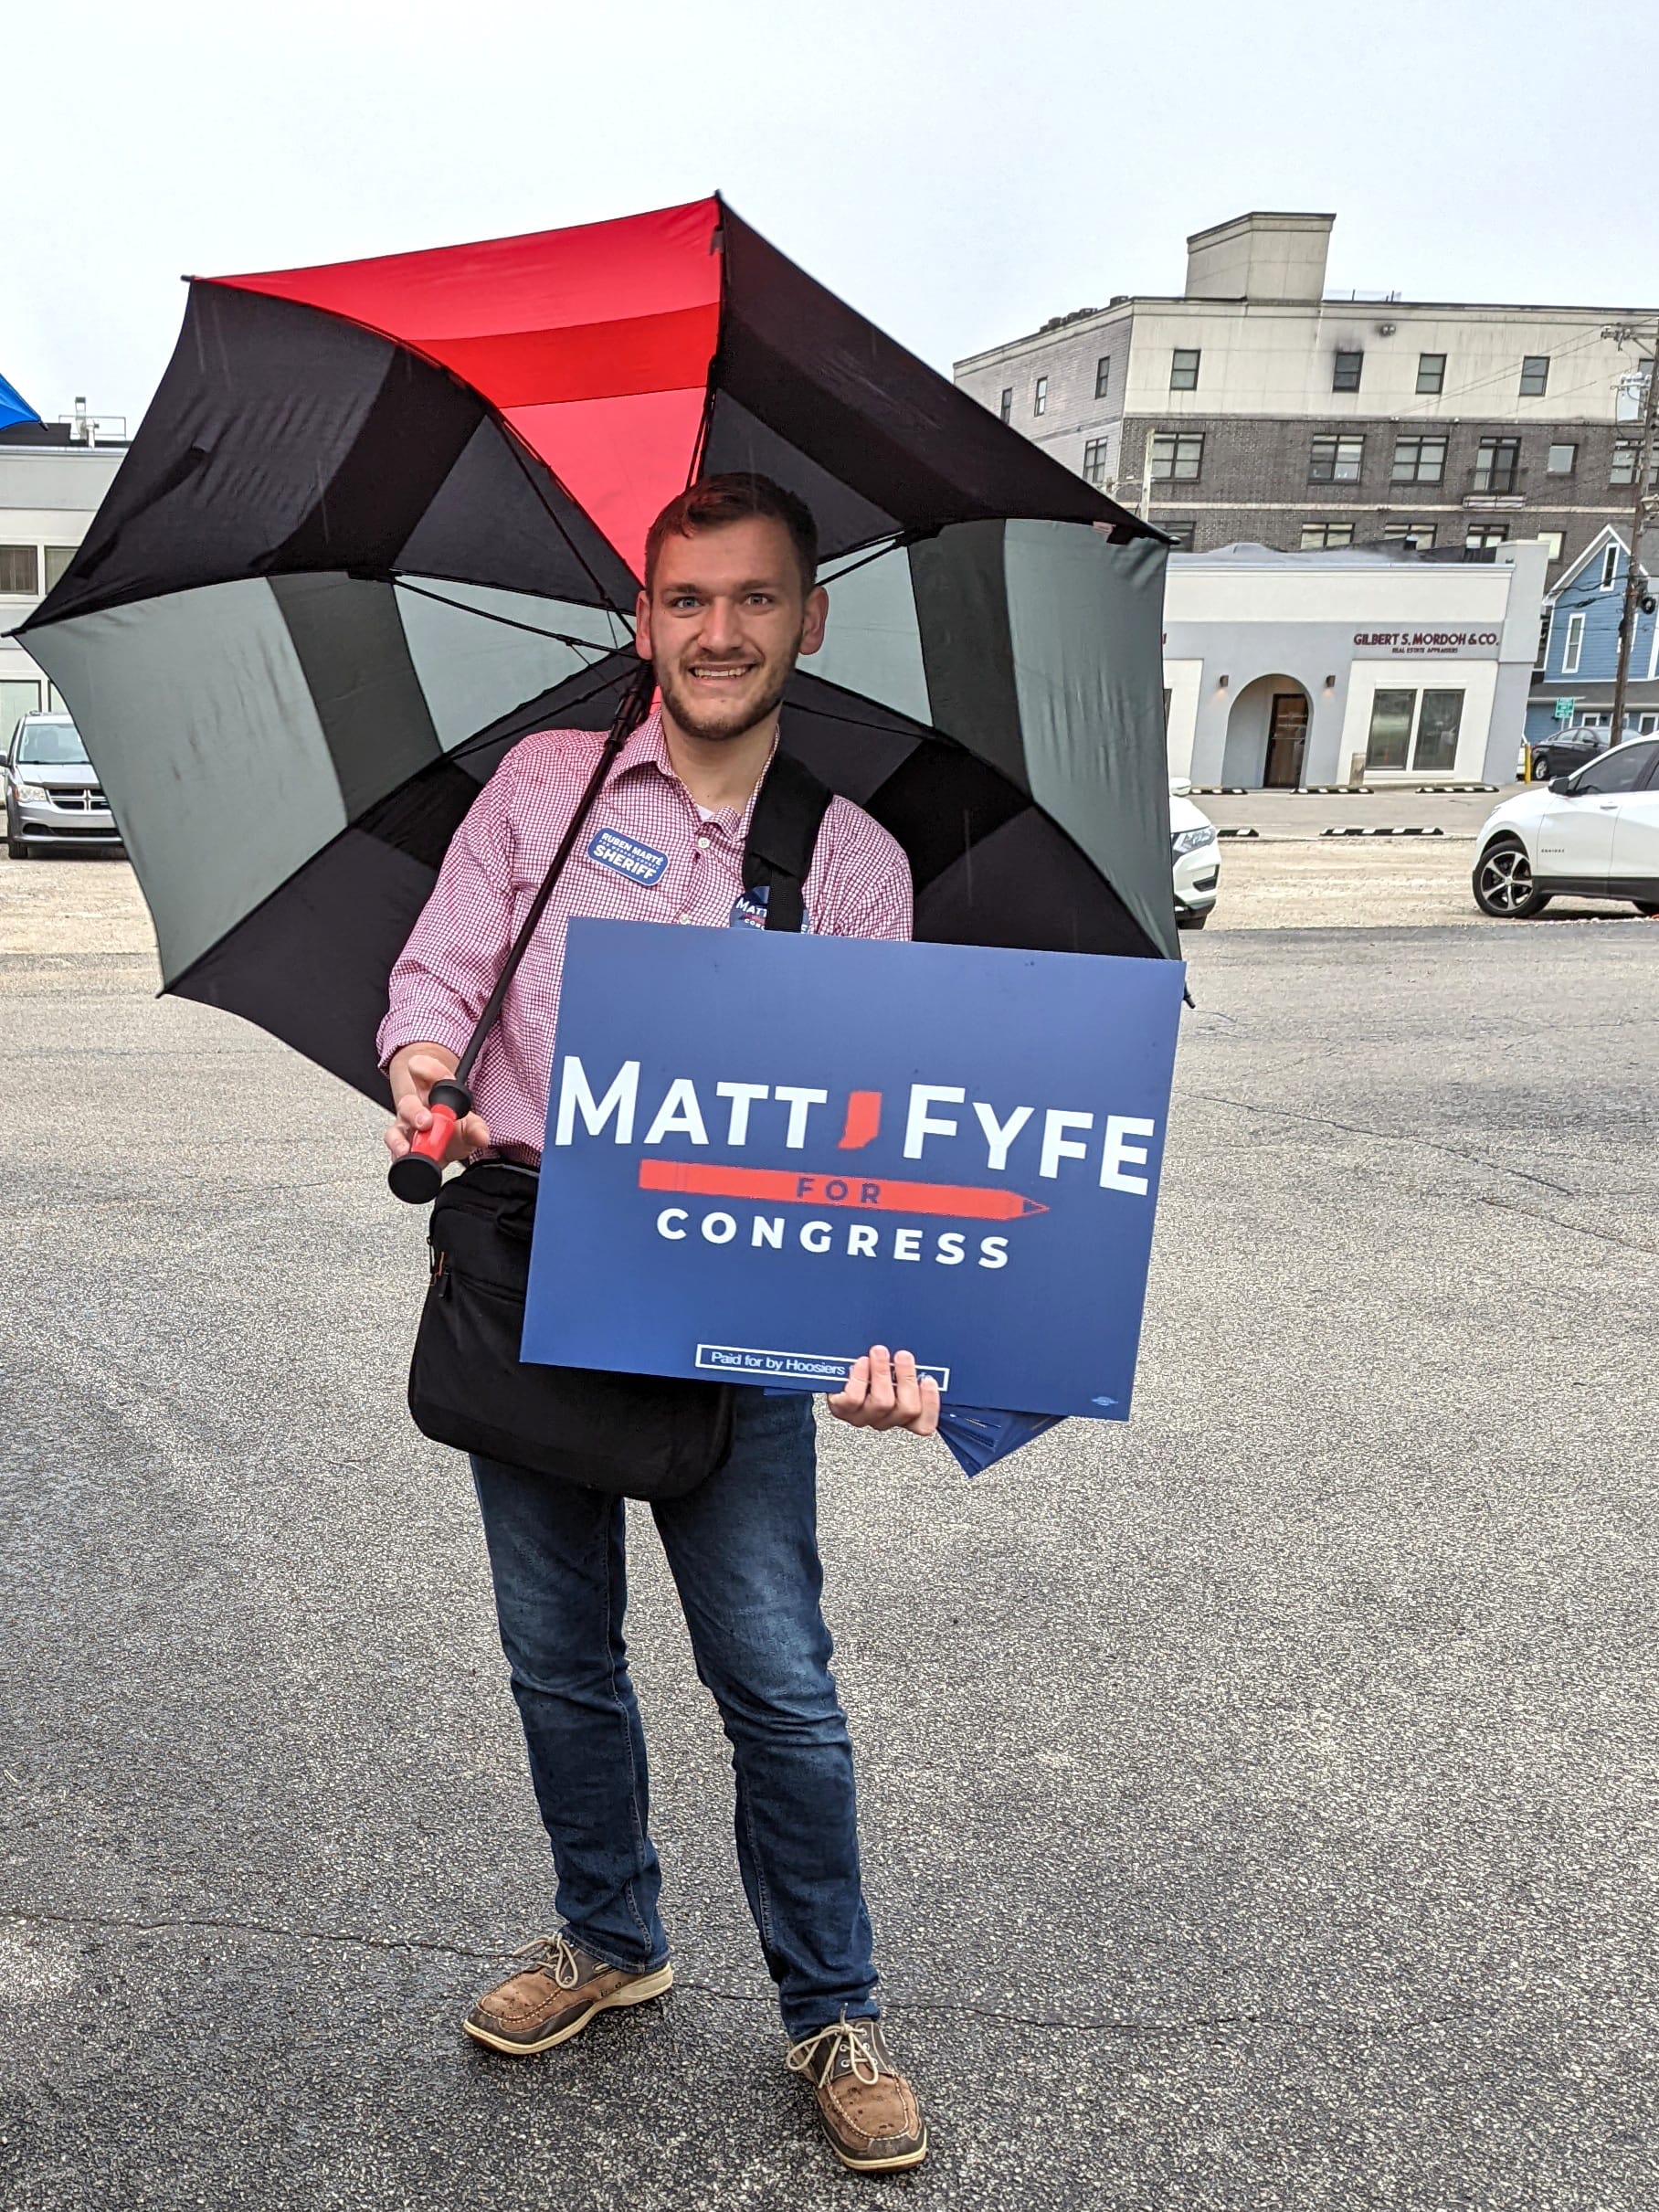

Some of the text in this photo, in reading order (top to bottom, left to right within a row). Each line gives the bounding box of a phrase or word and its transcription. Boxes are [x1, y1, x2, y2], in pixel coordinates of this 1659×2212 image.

[1353, 632, 1499, 646] GILBERT S. MORDOH & CO.
[601, 832, 633, 852] RUBEN
[593, 844, 657, 879] SHERIFF
[555, 1055, 1155, 1196] MATT FYFE
[796, 1177, 882, 1205] FOR
[656, 1208, 1010, 1269] CONGRESS
[711, 1351, 742, 1366] Paid
[745, 1355, 762, 1369] for
[766, 1358, 783, 1372] by
[786, 1359, 846, 1376] Hoosiers
